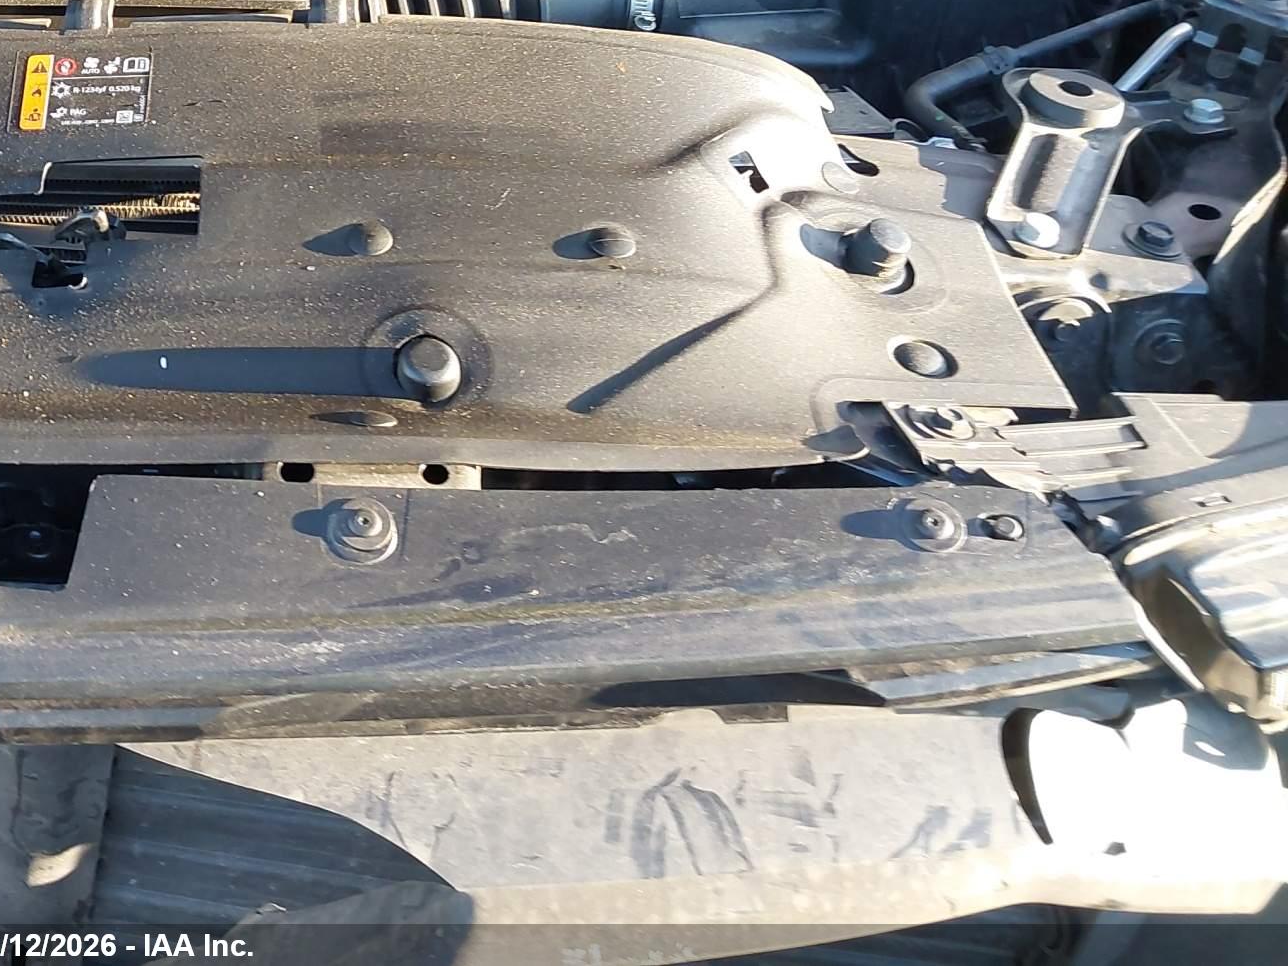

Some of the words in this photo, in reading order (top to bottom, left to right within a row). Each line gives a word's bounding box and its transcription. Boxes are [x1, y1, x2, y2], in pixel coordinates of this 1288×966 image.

[72, 85, 107, 94] R-1234yf
[108, 84, 130, 93] 0.520
[131, 84, 142, 94] kg
[69, 107, 87, 116] PAG
